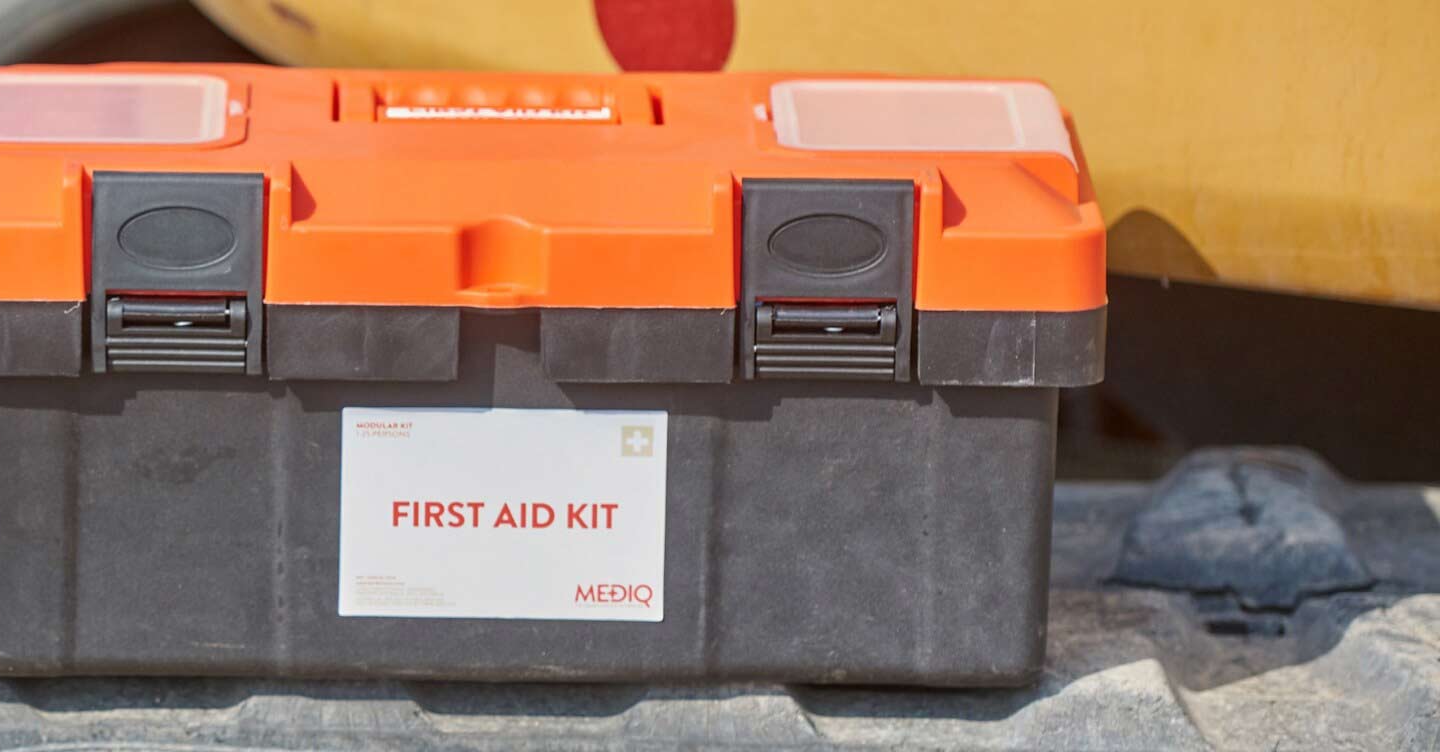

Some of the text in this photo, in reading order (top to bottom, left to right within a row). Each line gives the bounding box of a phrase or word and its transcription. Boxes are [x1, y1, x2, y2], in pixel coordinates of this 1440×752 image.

[356, 422, 413, 430] MODULAR KIT
[392, 501, 619, 529] FIRST AID KIT
[575, 584, 654, 608] MEDIQ
